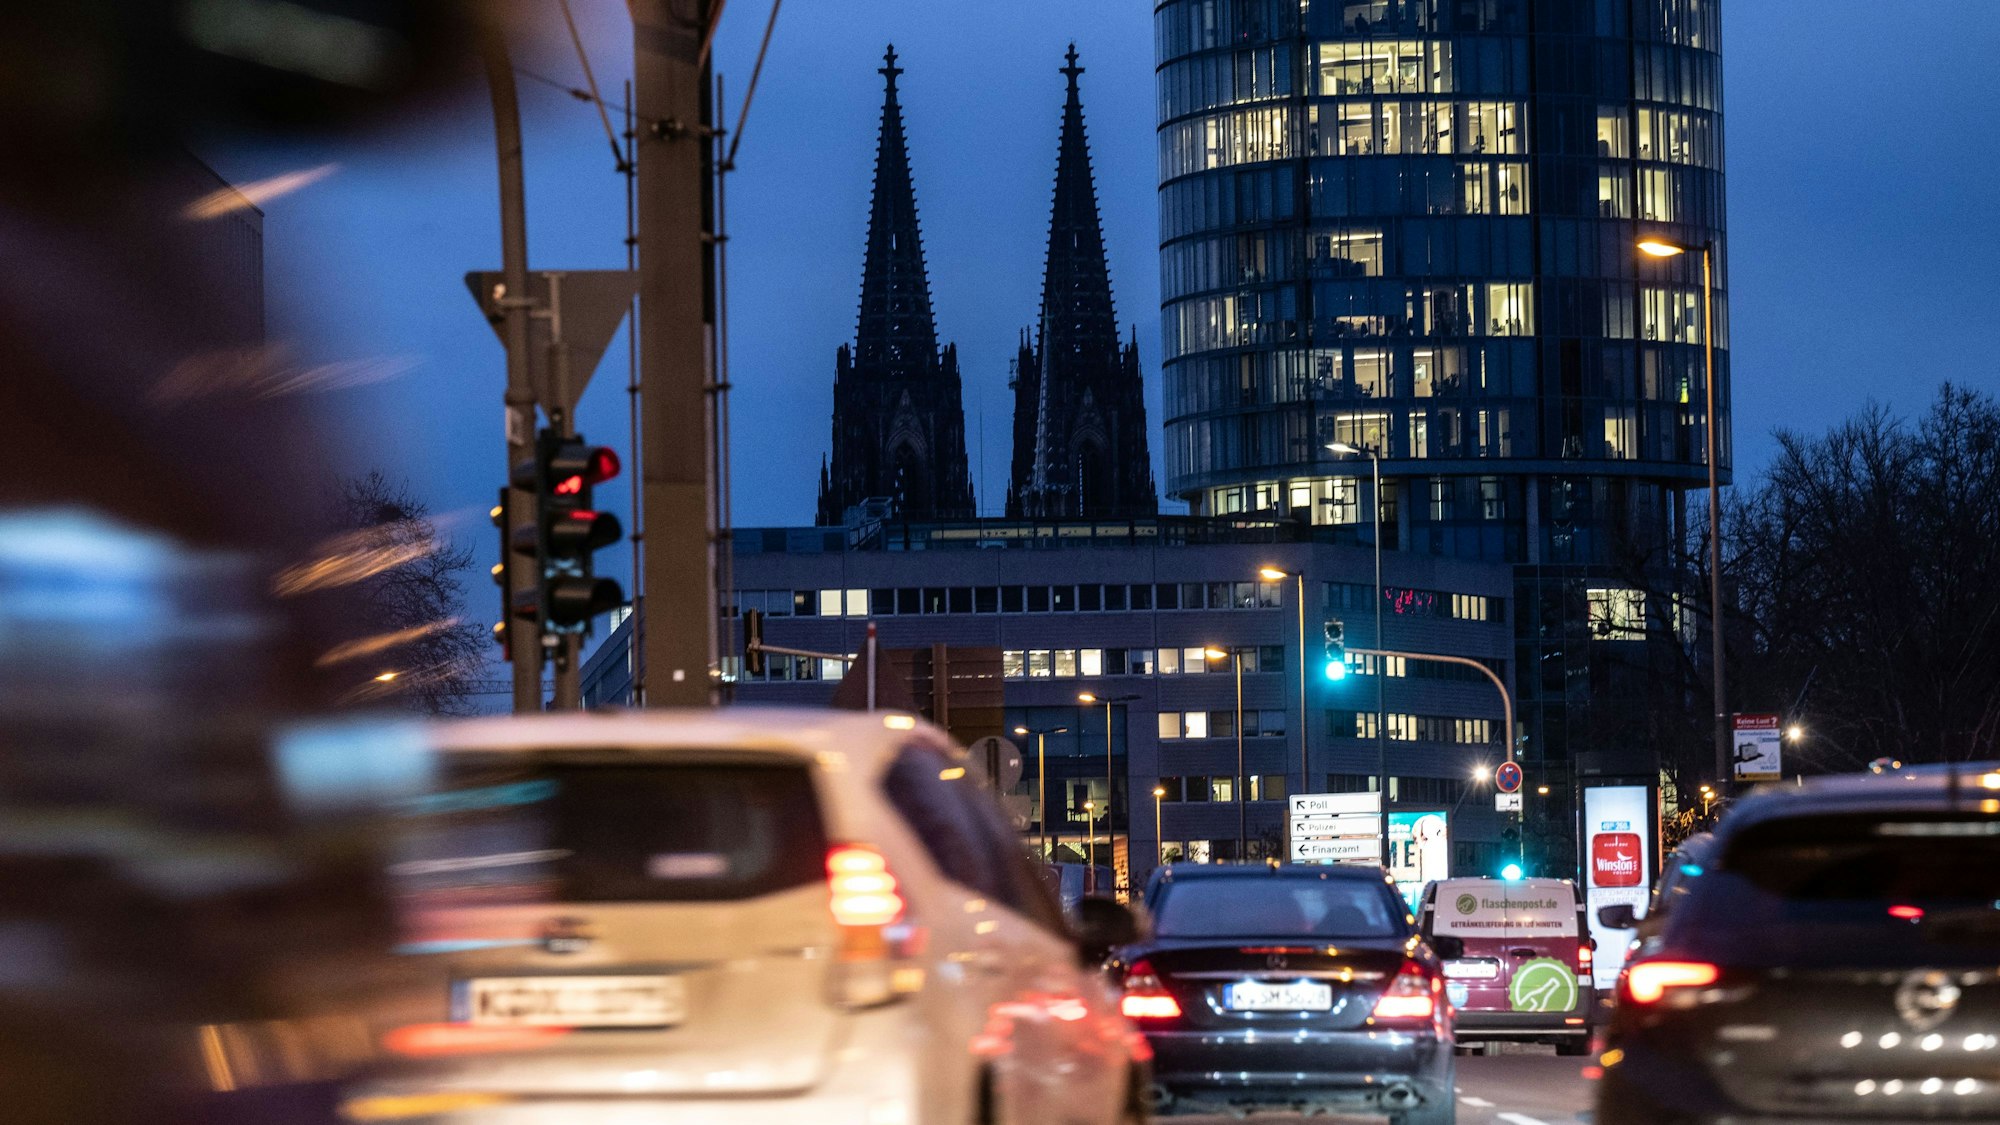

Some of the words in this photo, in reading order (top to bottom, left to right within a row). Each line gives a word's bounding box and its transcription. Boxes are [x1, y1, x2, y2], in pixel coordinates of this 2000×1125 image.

[1310, 801, 1328, 810] Poll
[1309, 823, 1337, 831] Polizei
[1312, 845, 1360, 854] Finanzamt
[1596, 857, 1633, 871] Winston
[1481, 898, 1558, 910] flaschenpost.de
